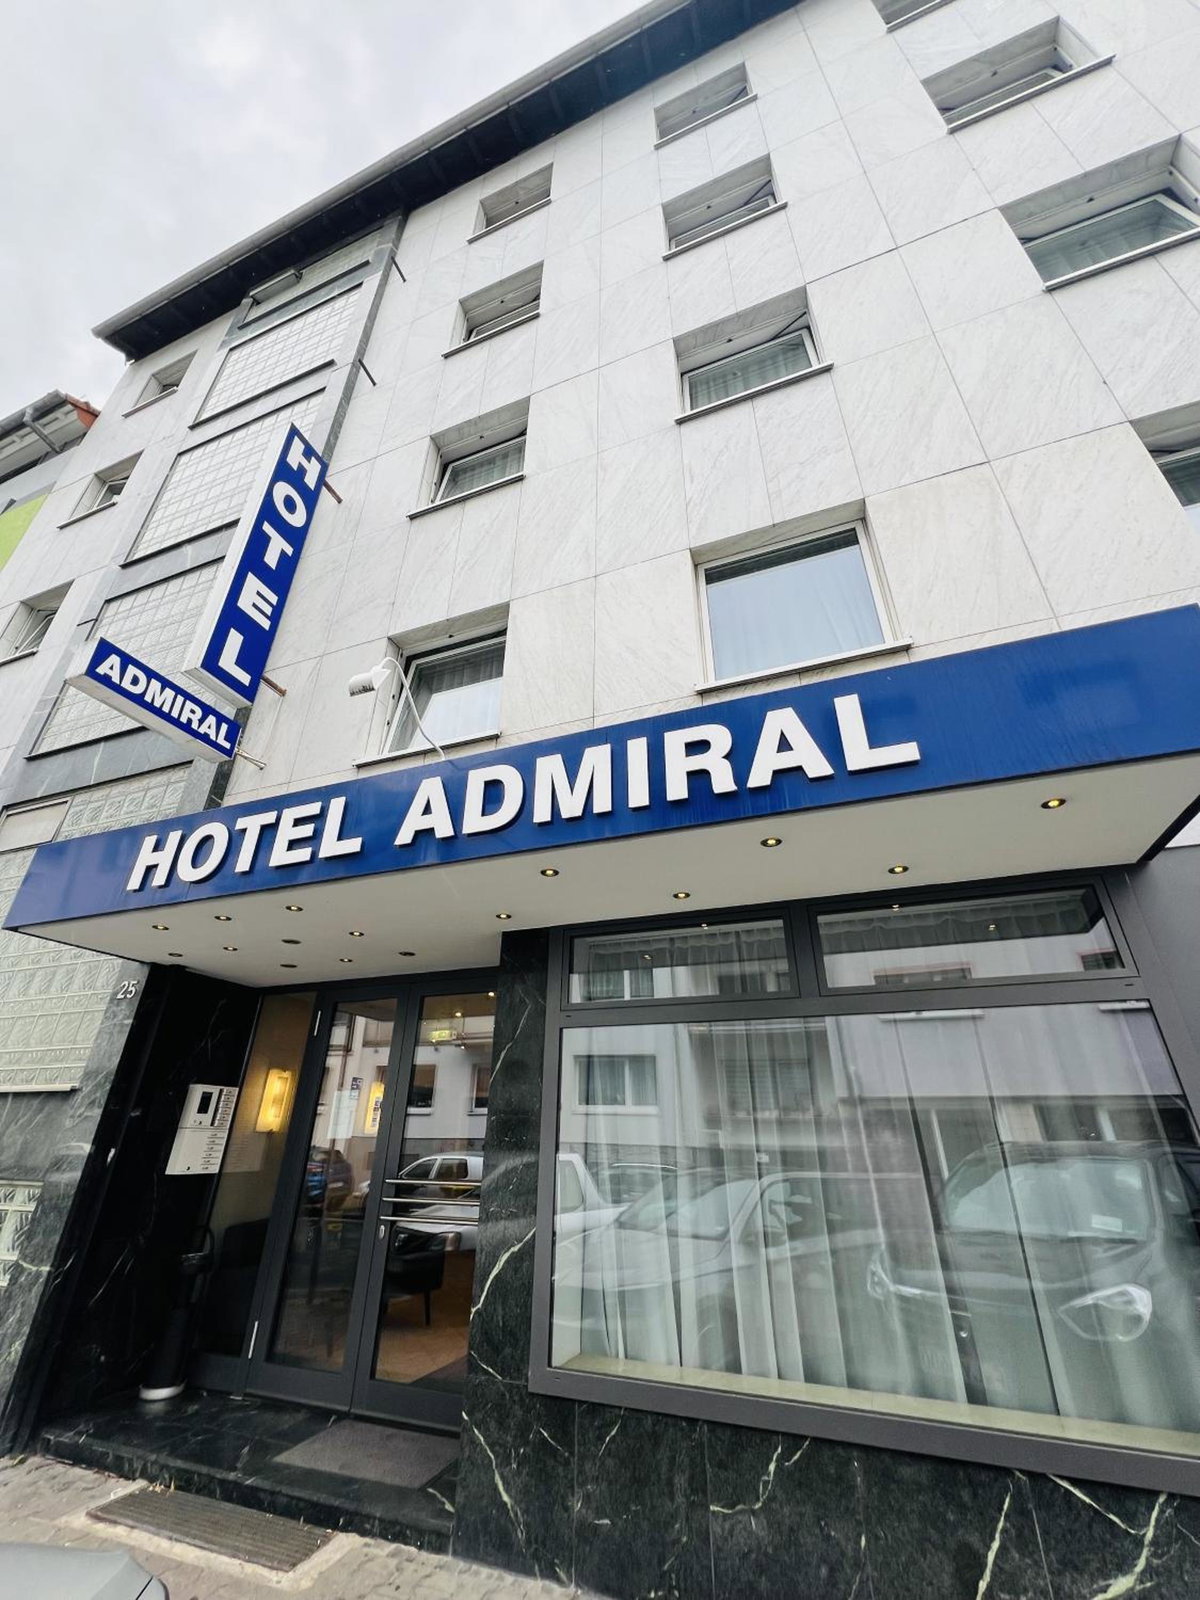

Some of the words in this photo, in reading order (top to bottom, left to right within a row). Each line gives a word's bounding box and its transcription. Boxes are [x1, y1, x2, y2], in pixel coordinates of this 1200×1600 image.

[219, 436, 321, 687] HOTEL
[95, 653, 232, 750] ADMIRAL
[126, 797, 362, 891] HOTEL
[394, 693, 921, 846] ADMIRAL
[116, 980, 138, 999] 25
